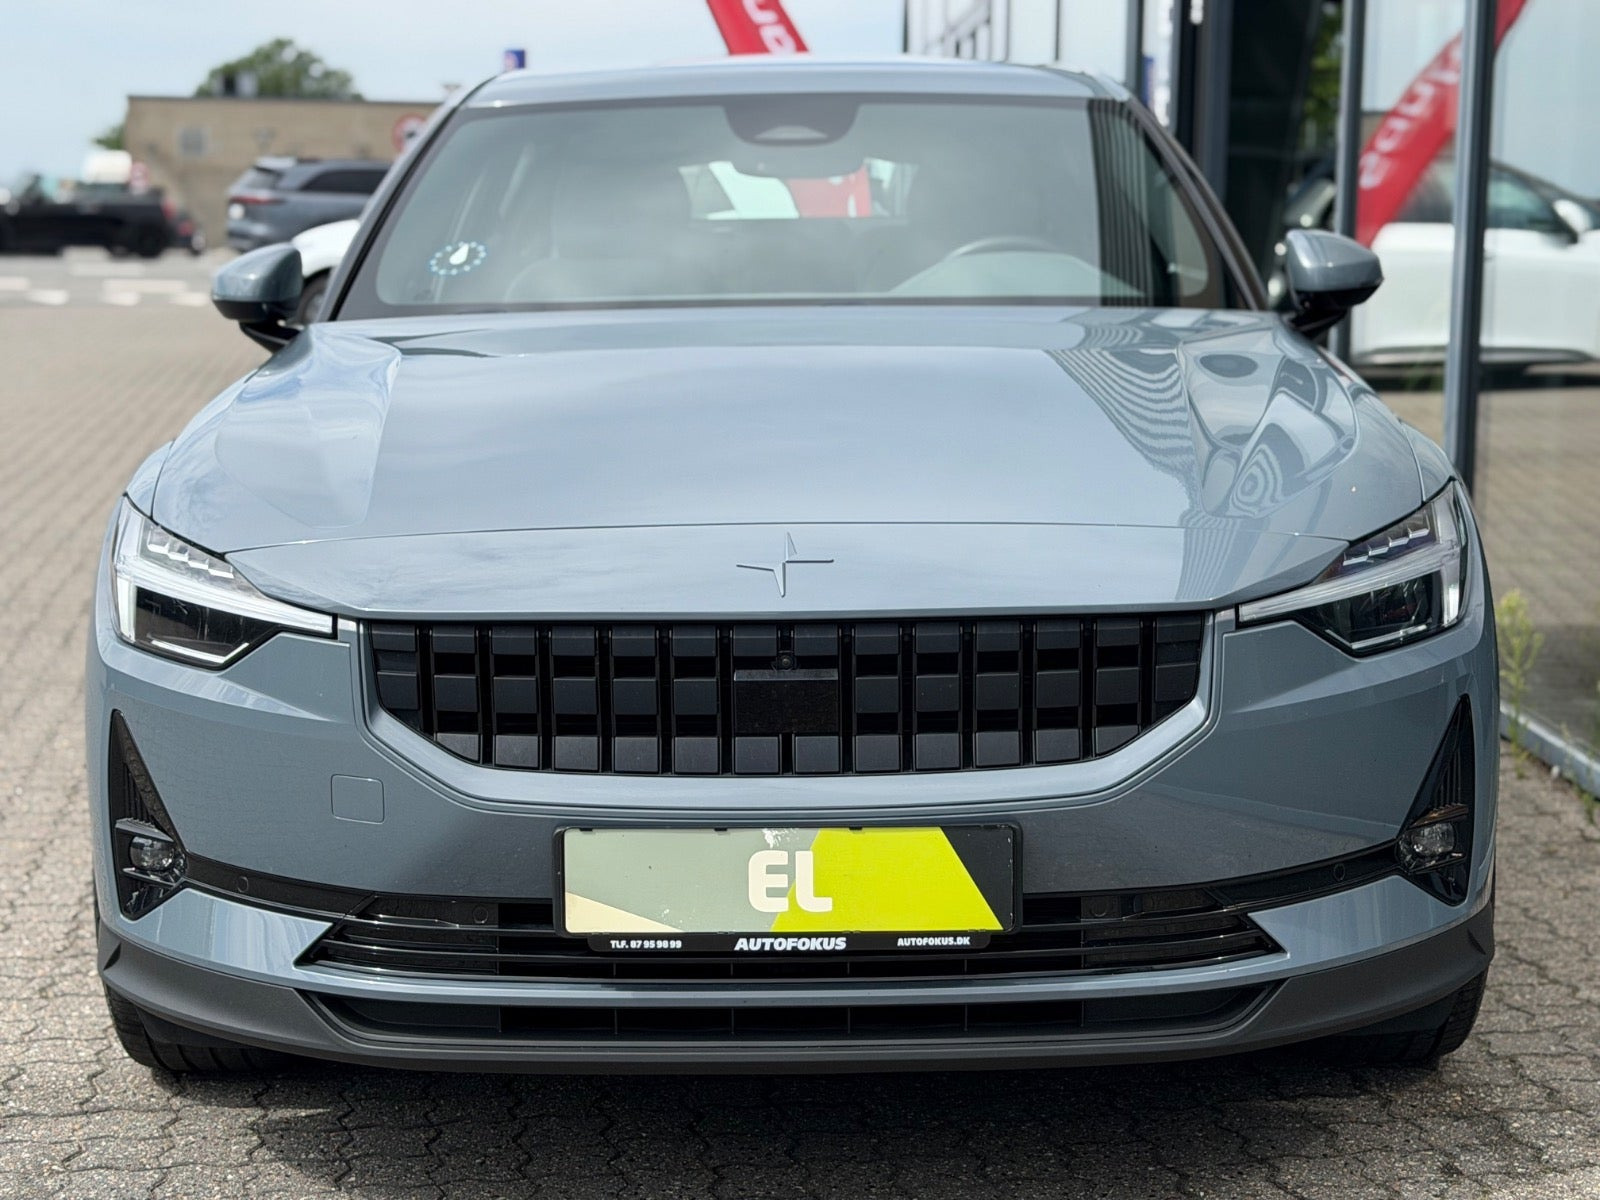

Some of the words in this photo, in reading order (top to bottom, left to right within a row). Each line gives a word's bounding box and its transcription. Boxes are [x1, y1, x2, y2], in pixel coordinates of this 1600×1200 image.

[748, 850, 833, 913] EL
[609, 939, 629, 949] TLF.
[669, 939, 682, 949] 99
[734, 937, 847, 951] AUTOFOKUS
[897, 936, 971, 947] AUTOFOKUS.DK
